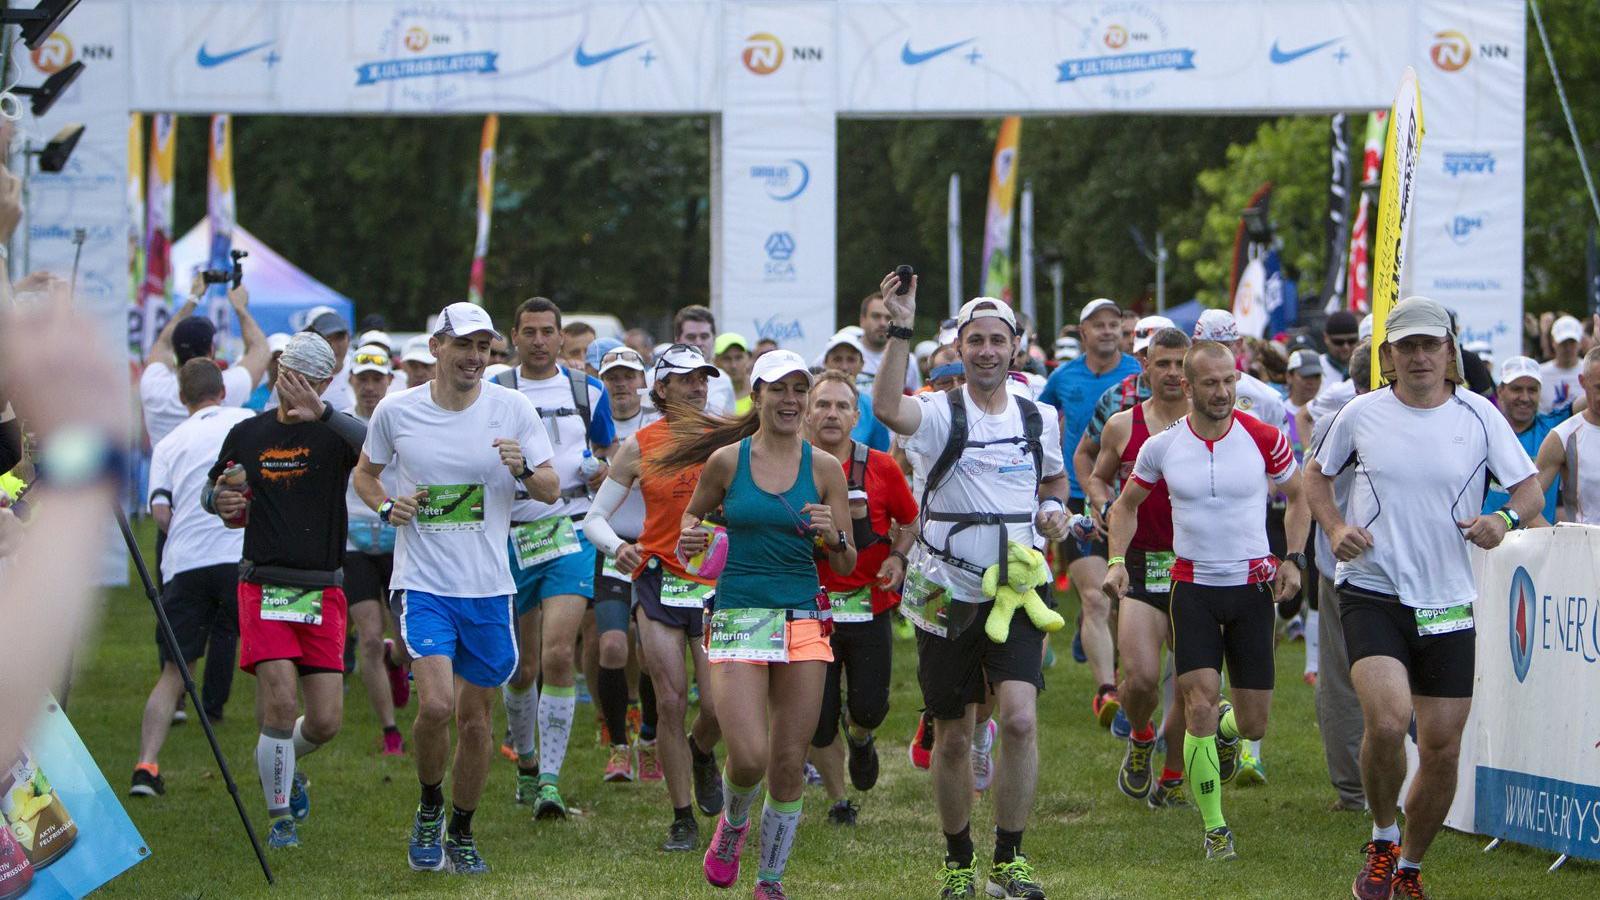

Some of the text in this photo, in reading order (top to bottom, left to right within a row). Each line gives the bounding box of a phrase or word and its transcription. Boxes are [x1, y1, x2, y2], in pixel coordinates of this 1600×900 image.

[82, 44, 113, 59] NN
[792, 47, 823, 60] NN
[1479, 44, 1510, 58] NN
[418, 505, 444, 516] Péter
[712, 631, 750, 641] Marina
